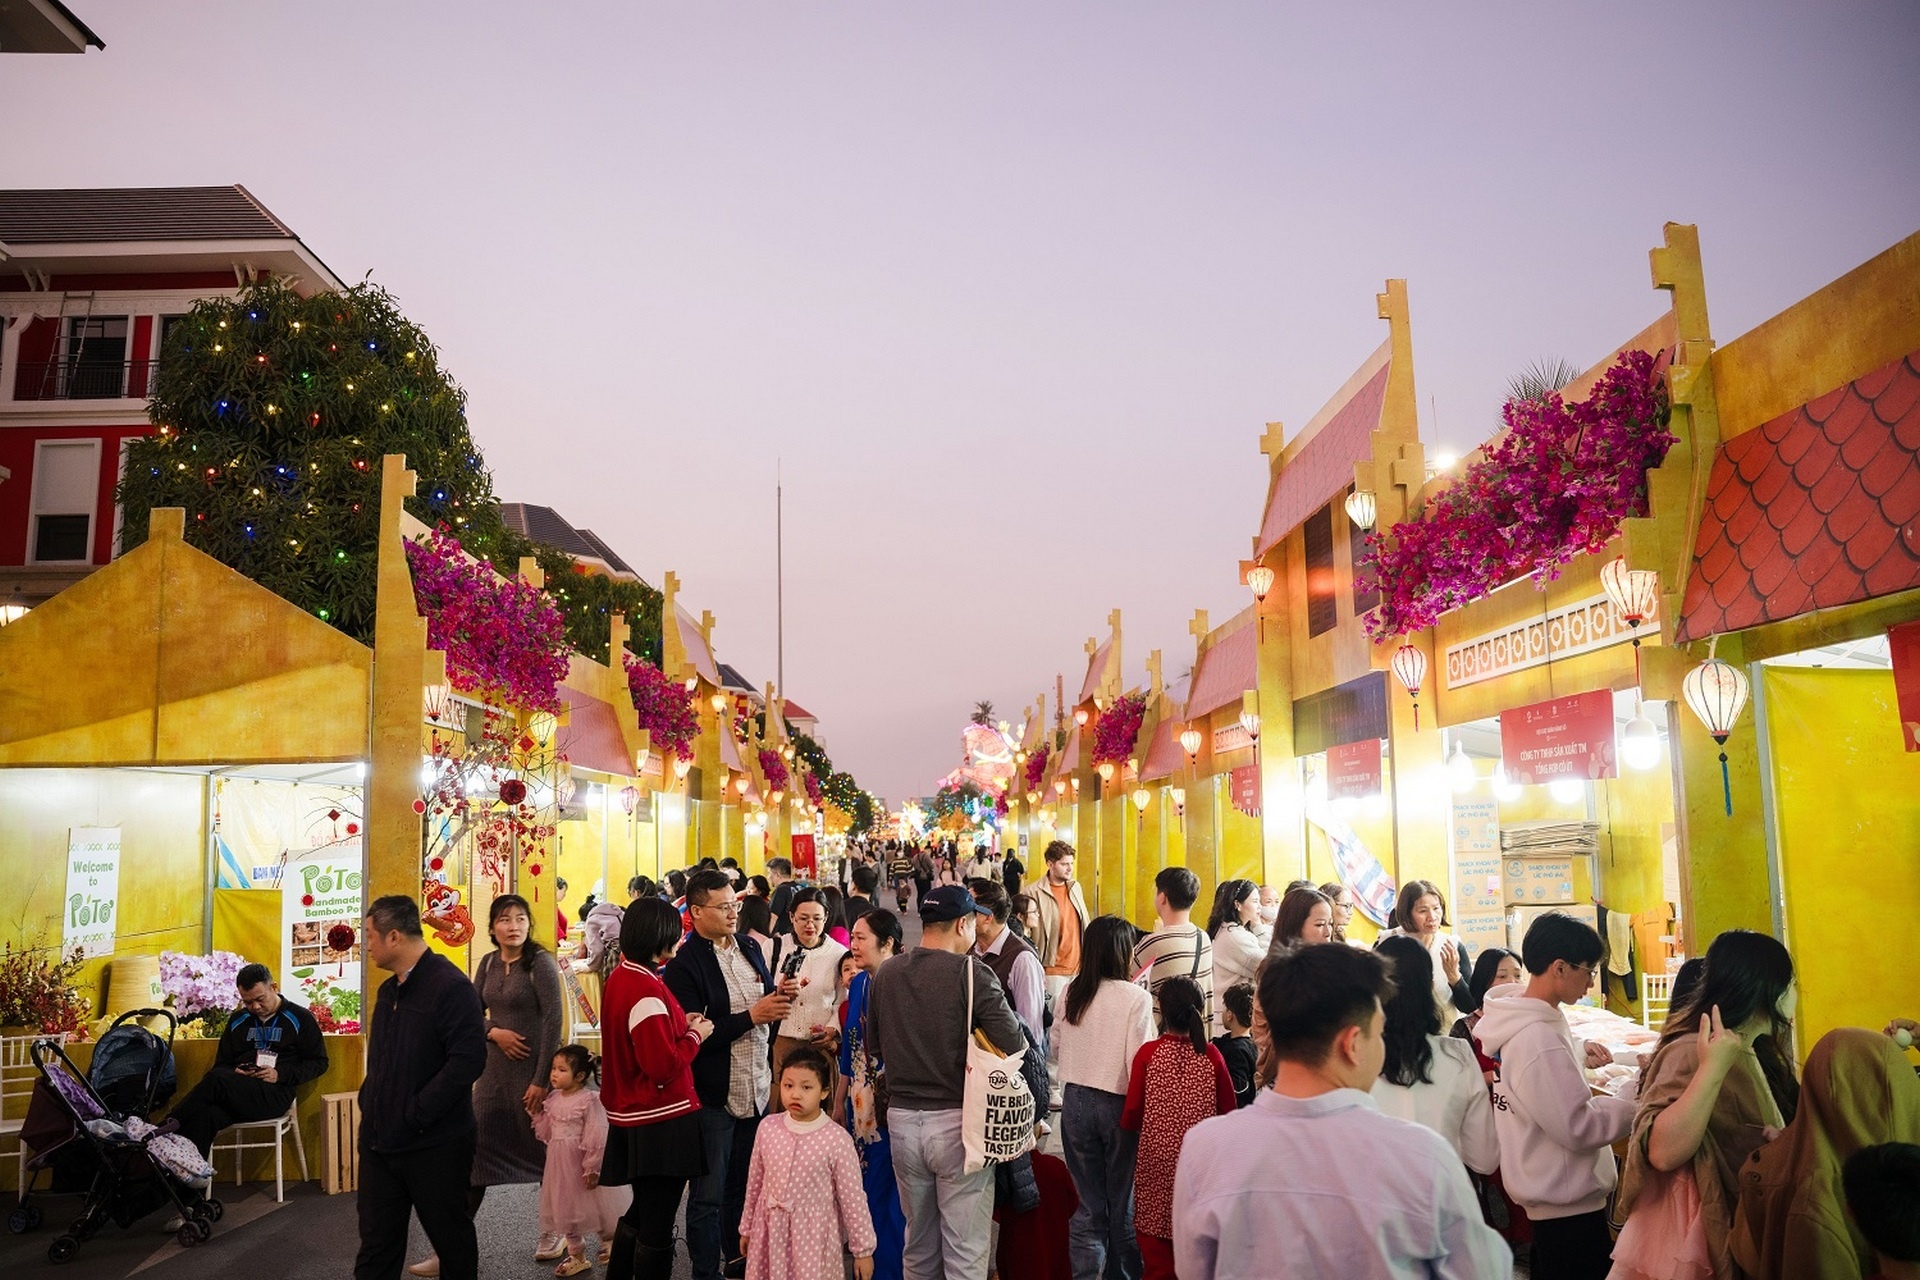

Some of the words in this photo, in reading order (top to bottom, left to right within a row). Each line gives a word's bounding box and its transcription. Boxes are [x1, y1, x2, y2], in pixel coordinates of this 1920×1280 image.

[73, 860, 114, 874] Welcome
[89, 876, 98, 886] to
[312, 895, 361, 907] andmade
[305, 904, 344, 917] Bamboo
[347, 905, 362, 915] Po
[988, 1075, 1008, 1085] TEXAS
[986, 1093, 1006, 1108] WE
[984, 1141, 1014, 1155] TASTE
